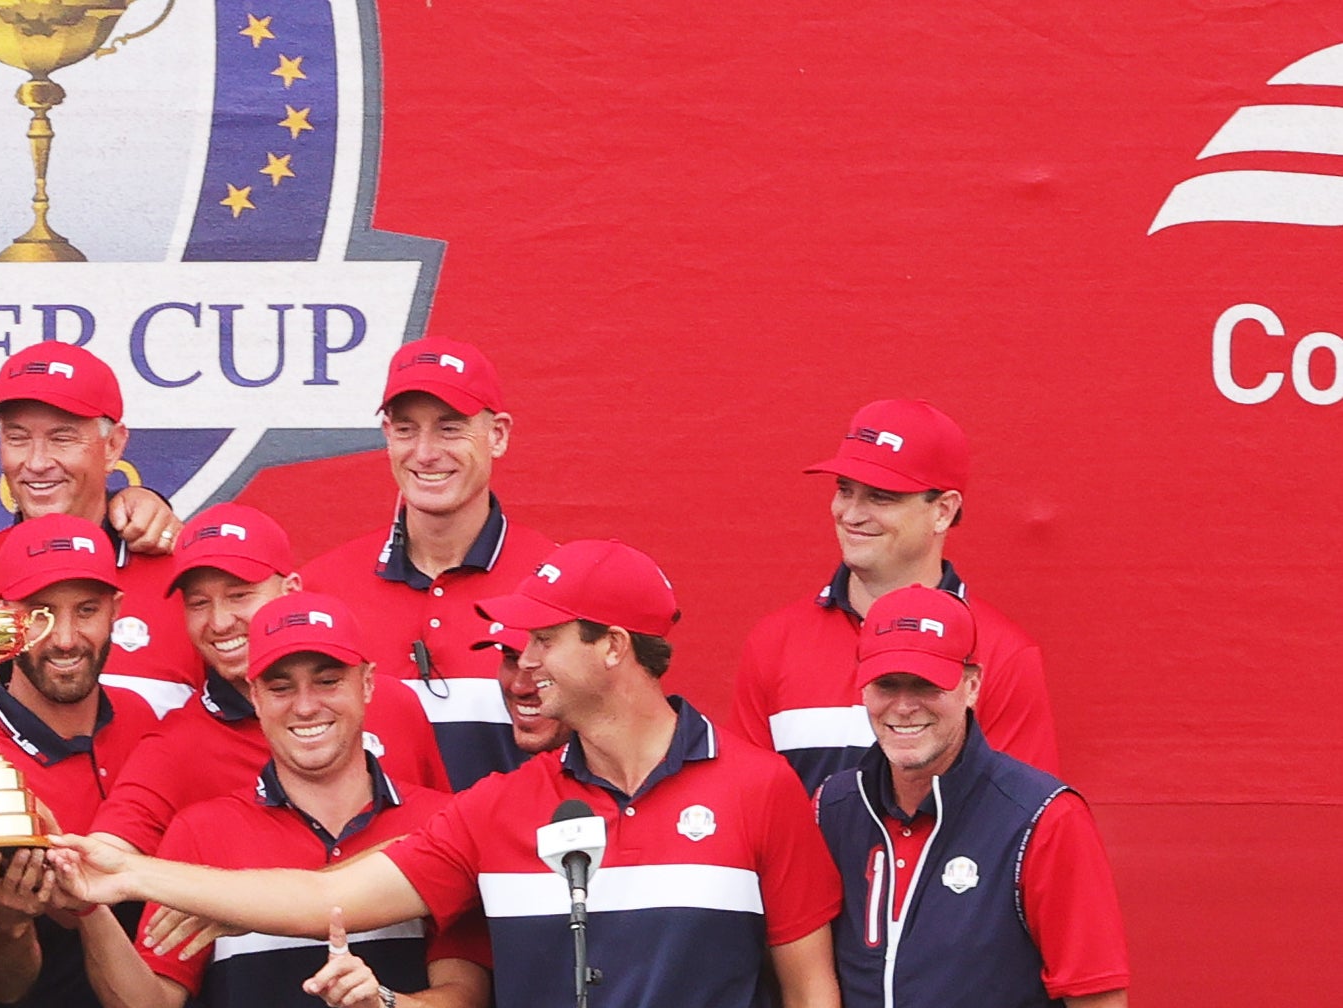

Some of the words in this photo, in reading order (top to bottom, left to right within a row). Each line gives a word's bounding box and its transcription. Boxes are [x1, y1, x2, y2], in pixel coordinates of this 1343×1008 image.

[128, 301, 368, 388] CUP
[1211, 302, 1343, 406] Co
[8, 360, 74, 380] USA
[27, 535, 96, 558] USA
[183, 522, 247, 549] USA
[265, 610, 334, 636] USA
[875, 616, 946, 638] USA
